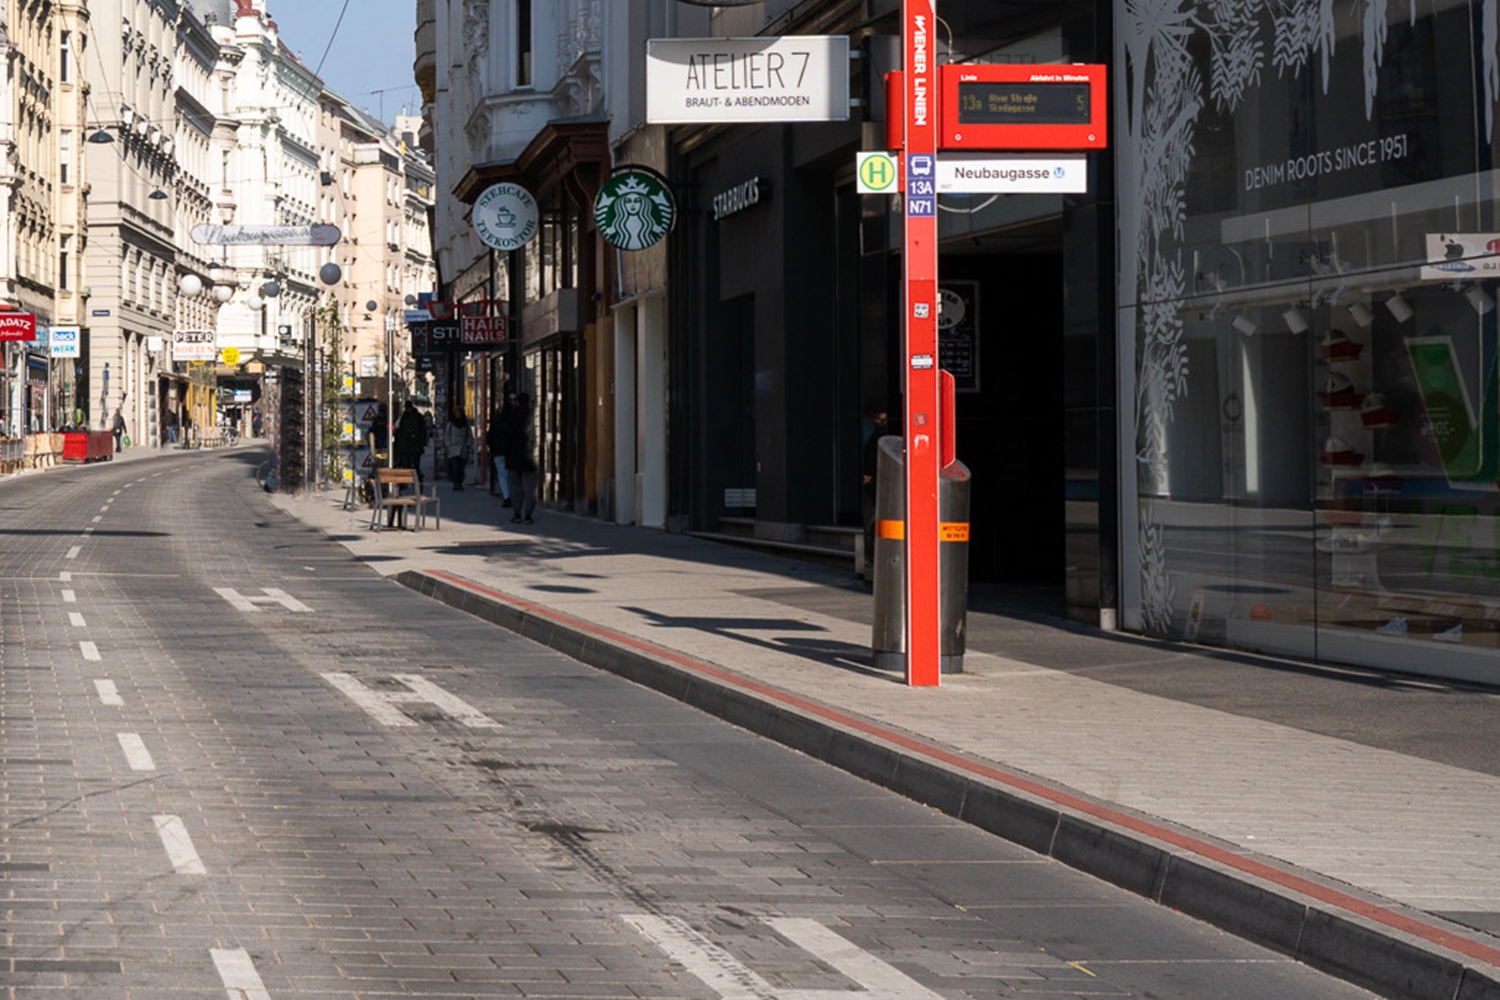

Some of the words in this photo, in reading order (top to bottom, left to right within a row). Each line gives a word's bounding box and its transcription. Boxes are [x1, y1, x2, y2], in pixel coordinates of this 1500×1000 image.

[913, 15, 927, 74] WIENER
[686, 53, 785, 91] ATELIER
[791, 51, 810, 89] 7
[685, 96, 723, 108] BRAUT-
[724, 96, 733, 107] &
[734, 95, 811, 107] ABENDMODEN
[913, 77, 927, 126] LINIEN
[869, 161, 886, 184] H
[1245, 162, 1285, 191] DENIM
[1287, 151, 1333, 182] ROOTS
[1335, 141, 1377, 171] SINCE
[1379, 133, 1408, 162] 1951
[954, 167, 1050, 182] Neubaugasse
[479, 186, 533, 208] STEHCAFE
[713, 176, 759, 221] STARBUCKS
[910, 181, 934, 195] 13A
[909, 200, 932, 214] N71
[477, 219, 536, 248] TEEKONTOR
[464, 318, 505, 330] HAIR
[175, 331, 214, 343] PETER
[464, 331, 505, 341] NAILS
